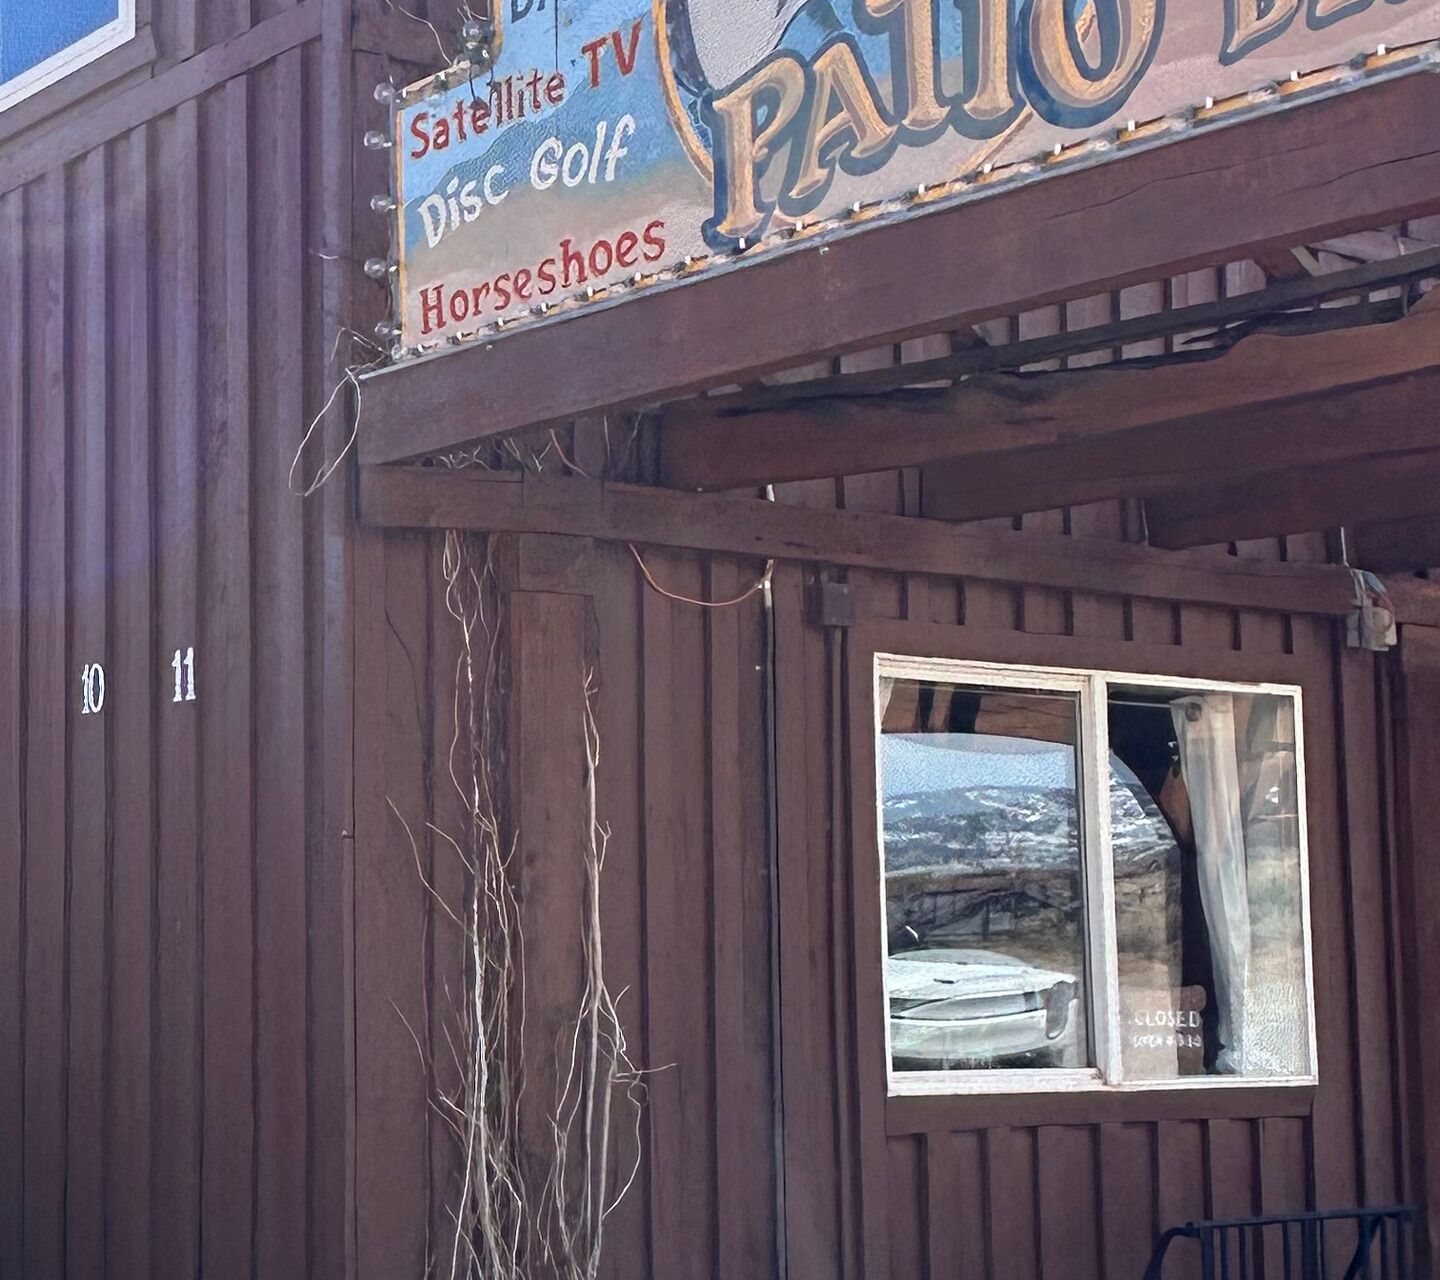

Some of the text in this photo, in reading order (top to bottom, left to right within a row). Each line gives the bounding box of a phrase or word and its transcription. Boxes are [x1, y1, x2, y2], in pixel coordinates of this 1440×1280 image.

[410, 20, 644, 159] Satellite TV
[418, 113, 636, 249] Disc Golf
[420, 220, 667, 334] Horseshoes
[81, 663, 105, 714] 10
[171, 647, 196, 702] 11
[1134, 1010, 1200, 1028] CLOSED
